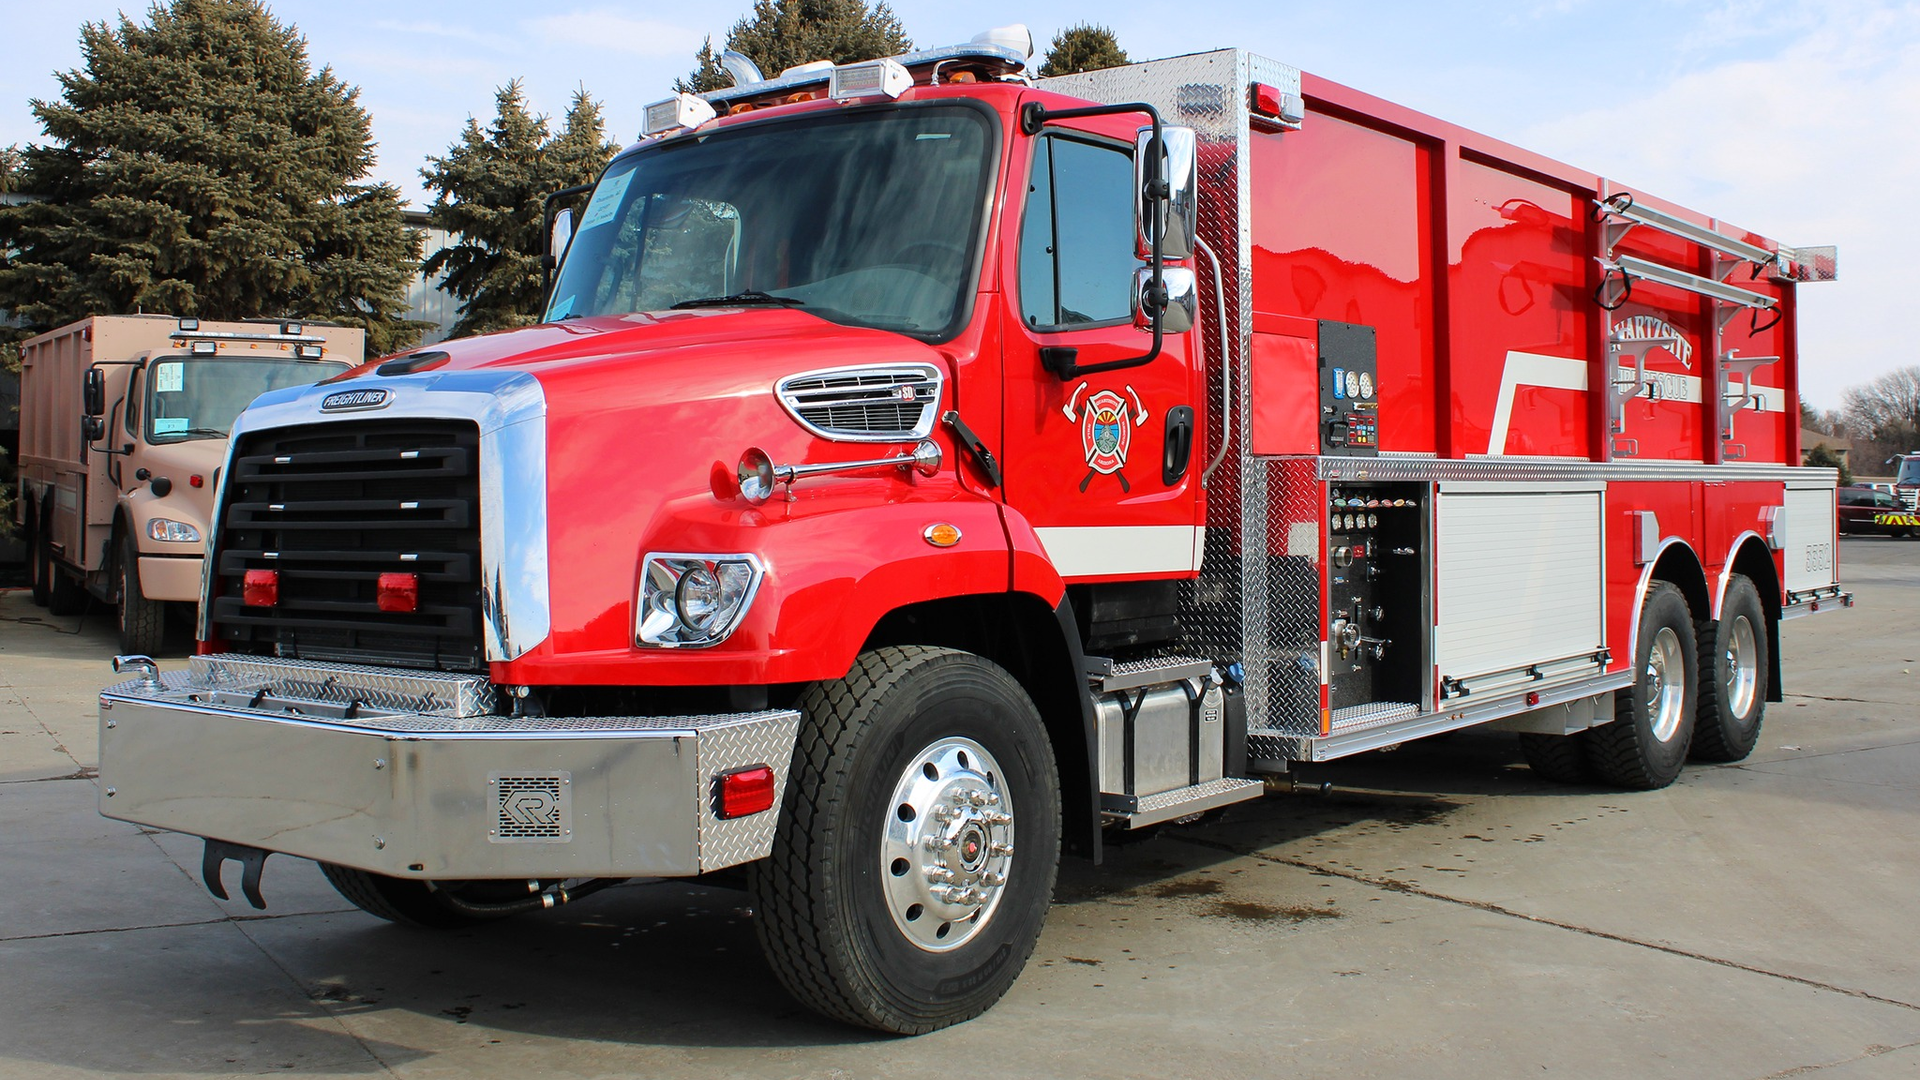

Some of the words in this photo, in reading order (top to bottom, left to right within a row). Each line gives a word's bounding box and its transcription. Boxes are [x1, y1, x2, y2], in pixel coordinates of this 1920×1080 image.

[1609, 315, 1693, 371] ARTZSITE
[324, 391, 385, 407] FREIGHTLINER
[902, 386, 914, 399] SD
